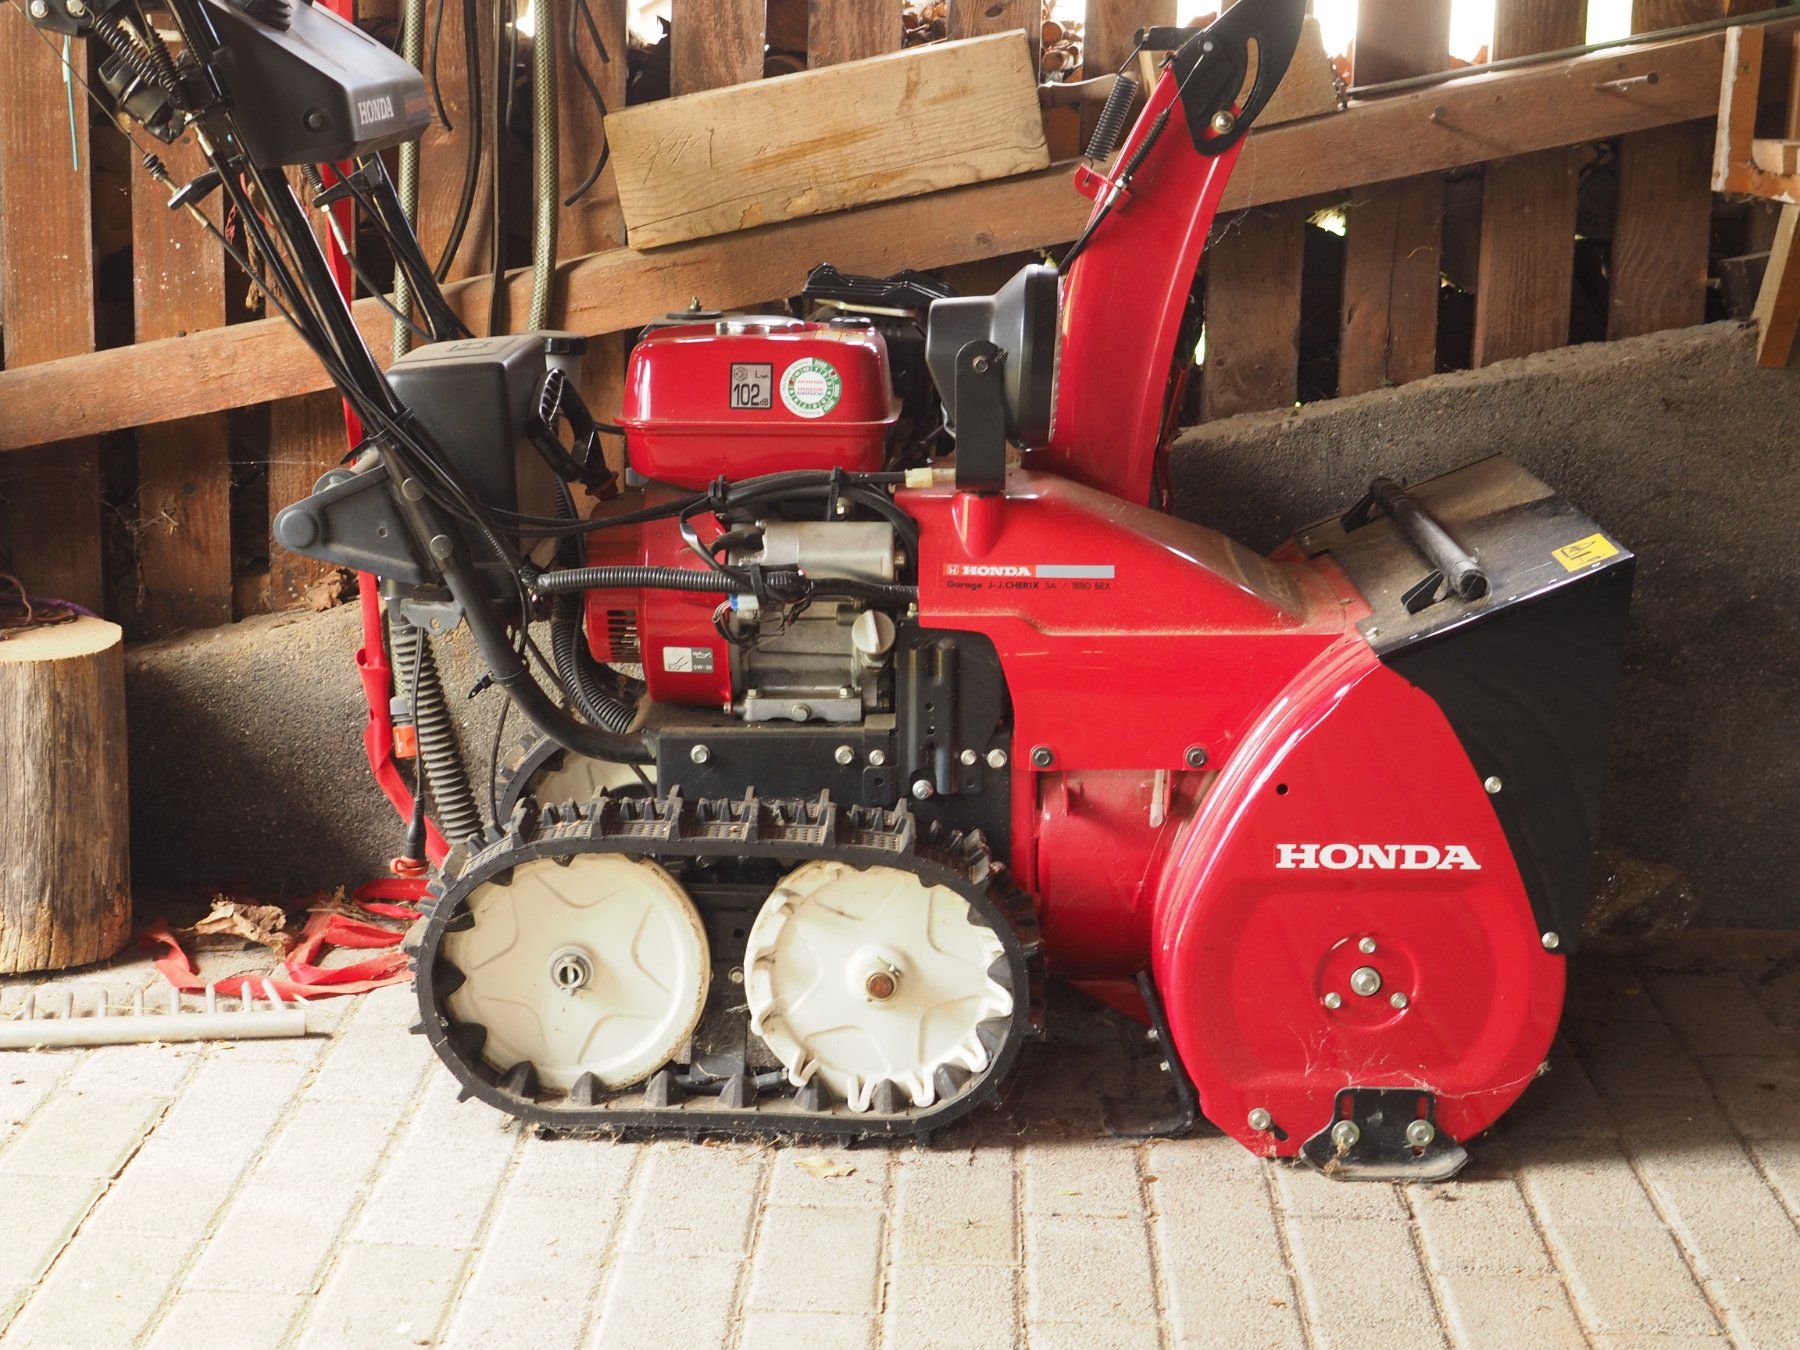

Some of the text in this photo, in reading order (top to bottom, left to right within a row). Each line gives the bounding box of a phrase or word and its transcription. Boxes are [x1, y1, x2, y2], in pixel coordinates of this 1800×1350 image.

[357, 96, 395, 125] HONDA
[962, 565, 1032, 577] HONDA
[946, 580, 983, 590] Garage
[1275, 843, 1482, 870] HONDA
